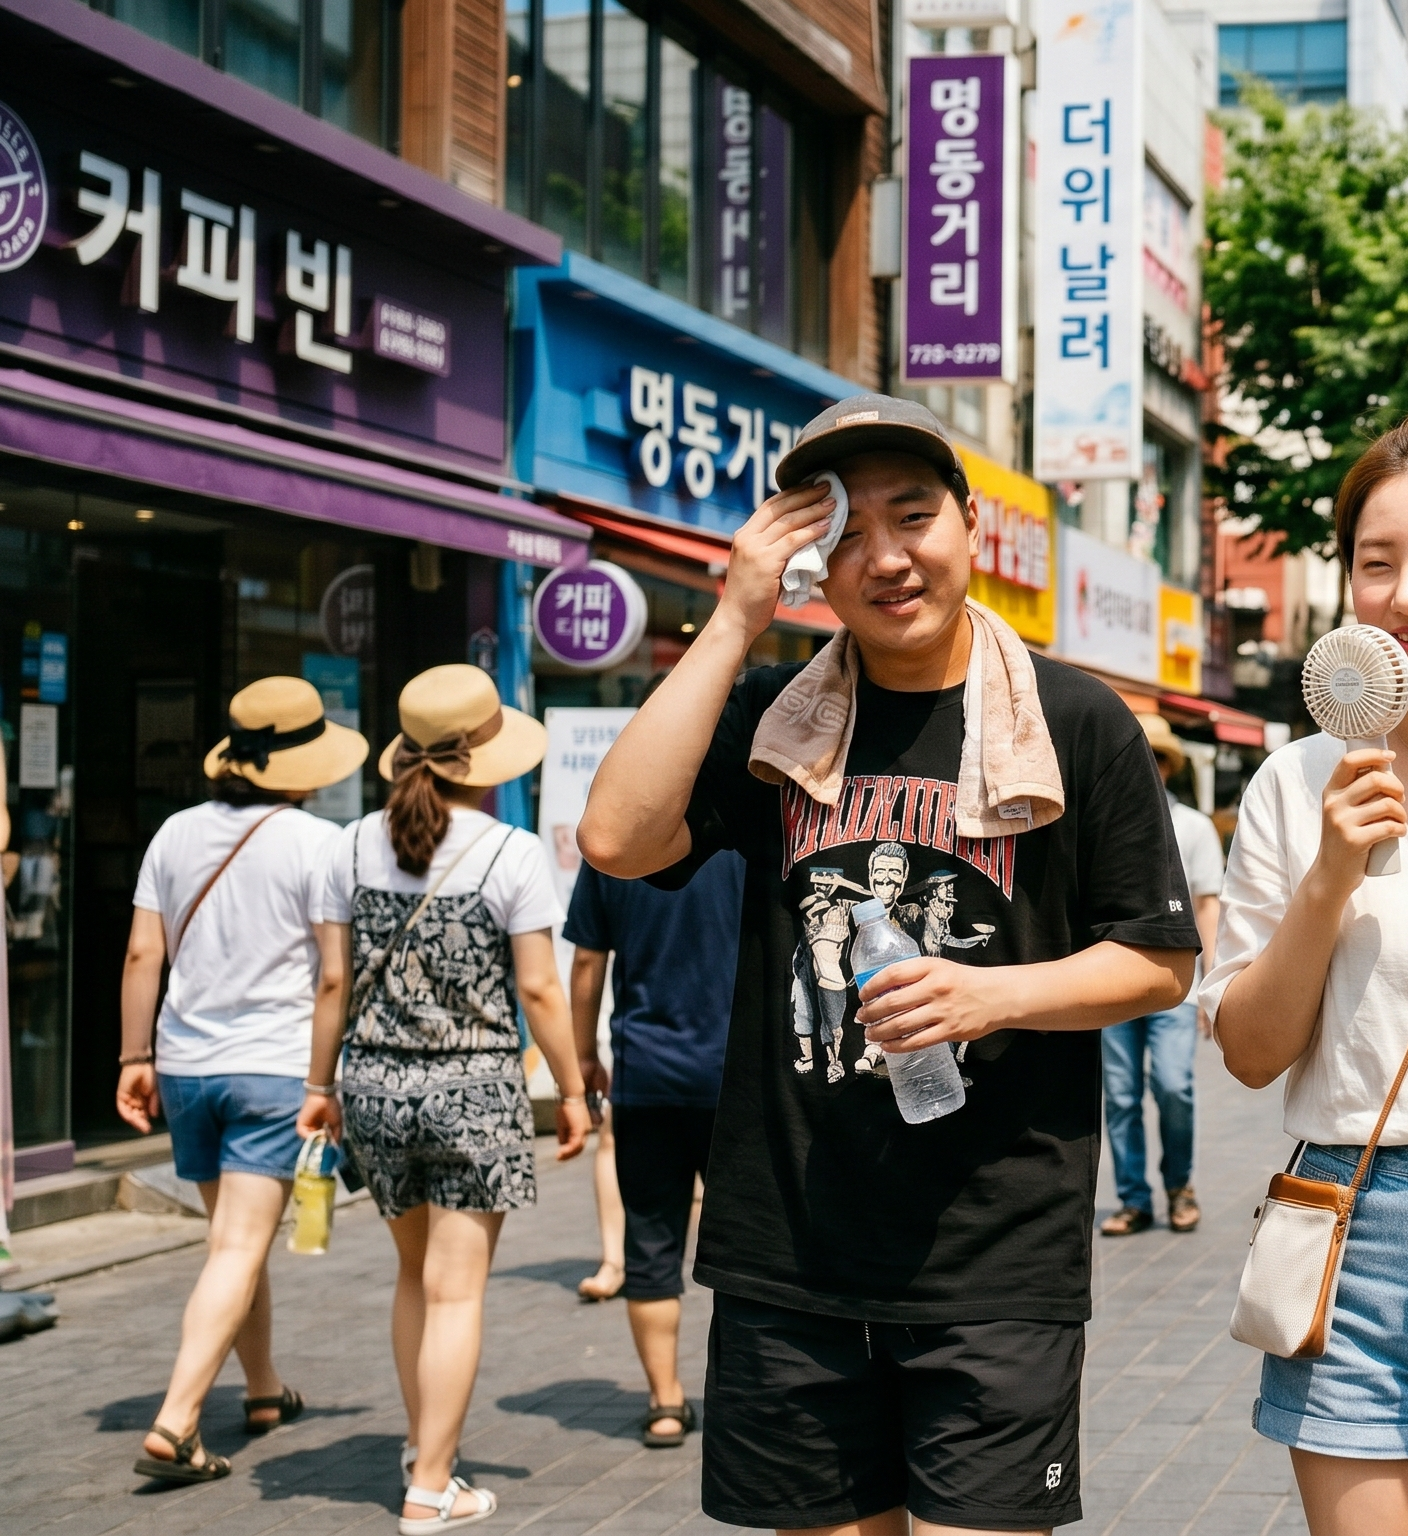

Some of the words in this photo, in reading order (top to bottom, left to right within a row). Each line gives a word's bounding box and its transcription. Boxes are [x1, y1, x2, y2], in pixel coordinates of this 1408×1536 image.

[77, 149, 352, 375] 커피빈
[930, 77, 984, 316] 명동거리
[556, 581, 611, 615] 커피
